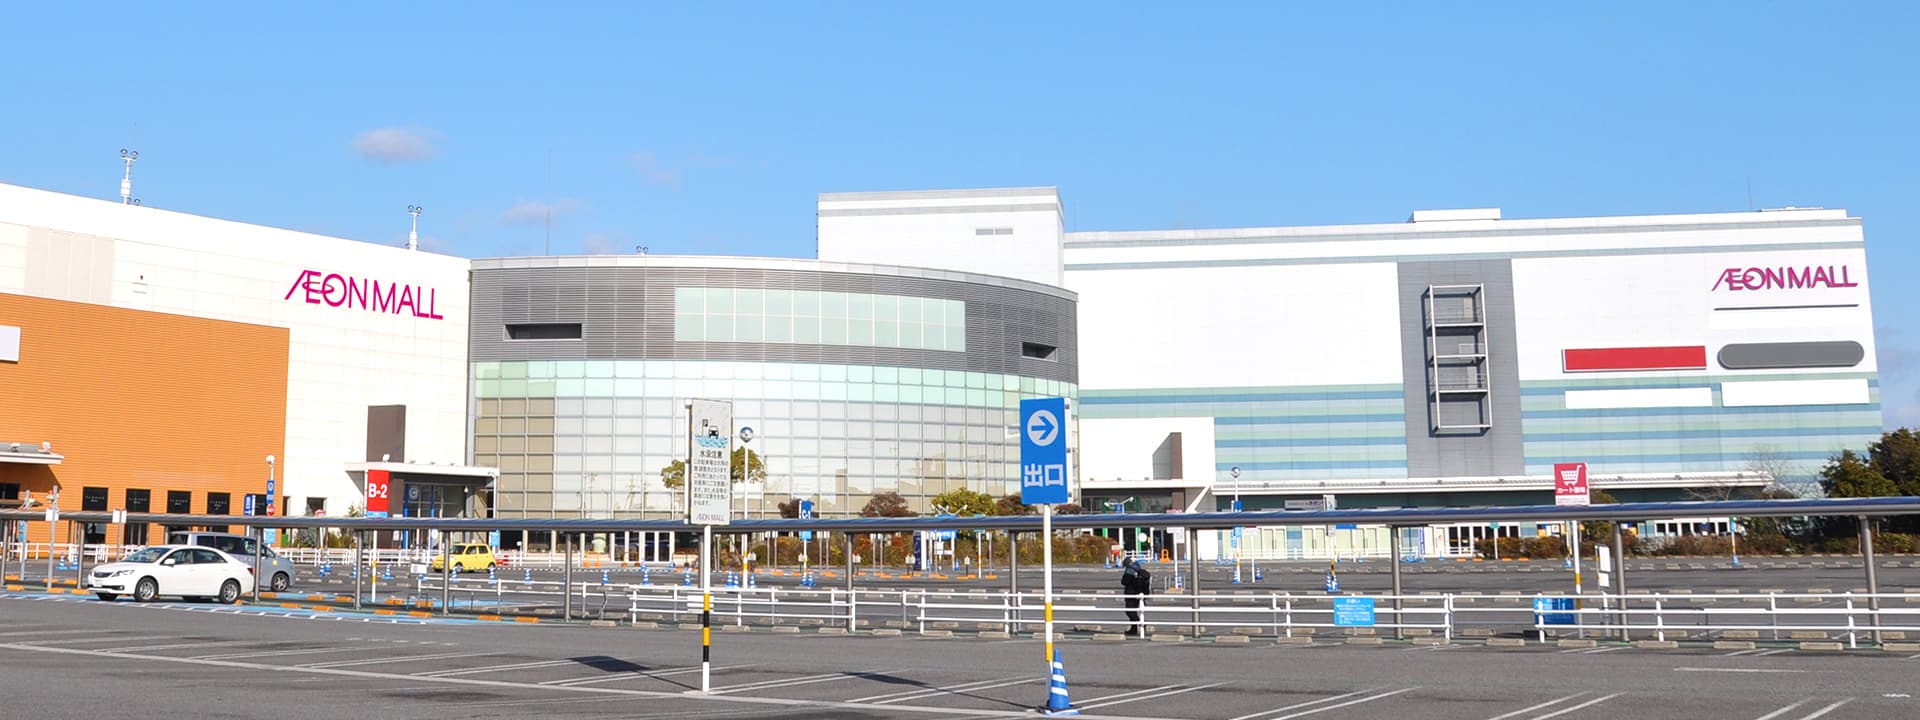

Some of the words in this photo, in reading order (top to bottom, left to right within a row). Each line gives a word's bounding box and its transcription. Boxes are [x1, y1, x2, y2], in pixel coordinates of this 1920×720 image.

[1787, 265, 1858, 289] MALL
[372, 279, 444, 320] MALL
[1023, 463, 1064, 487] 出口
[368, 483, 388, 499] B-2
